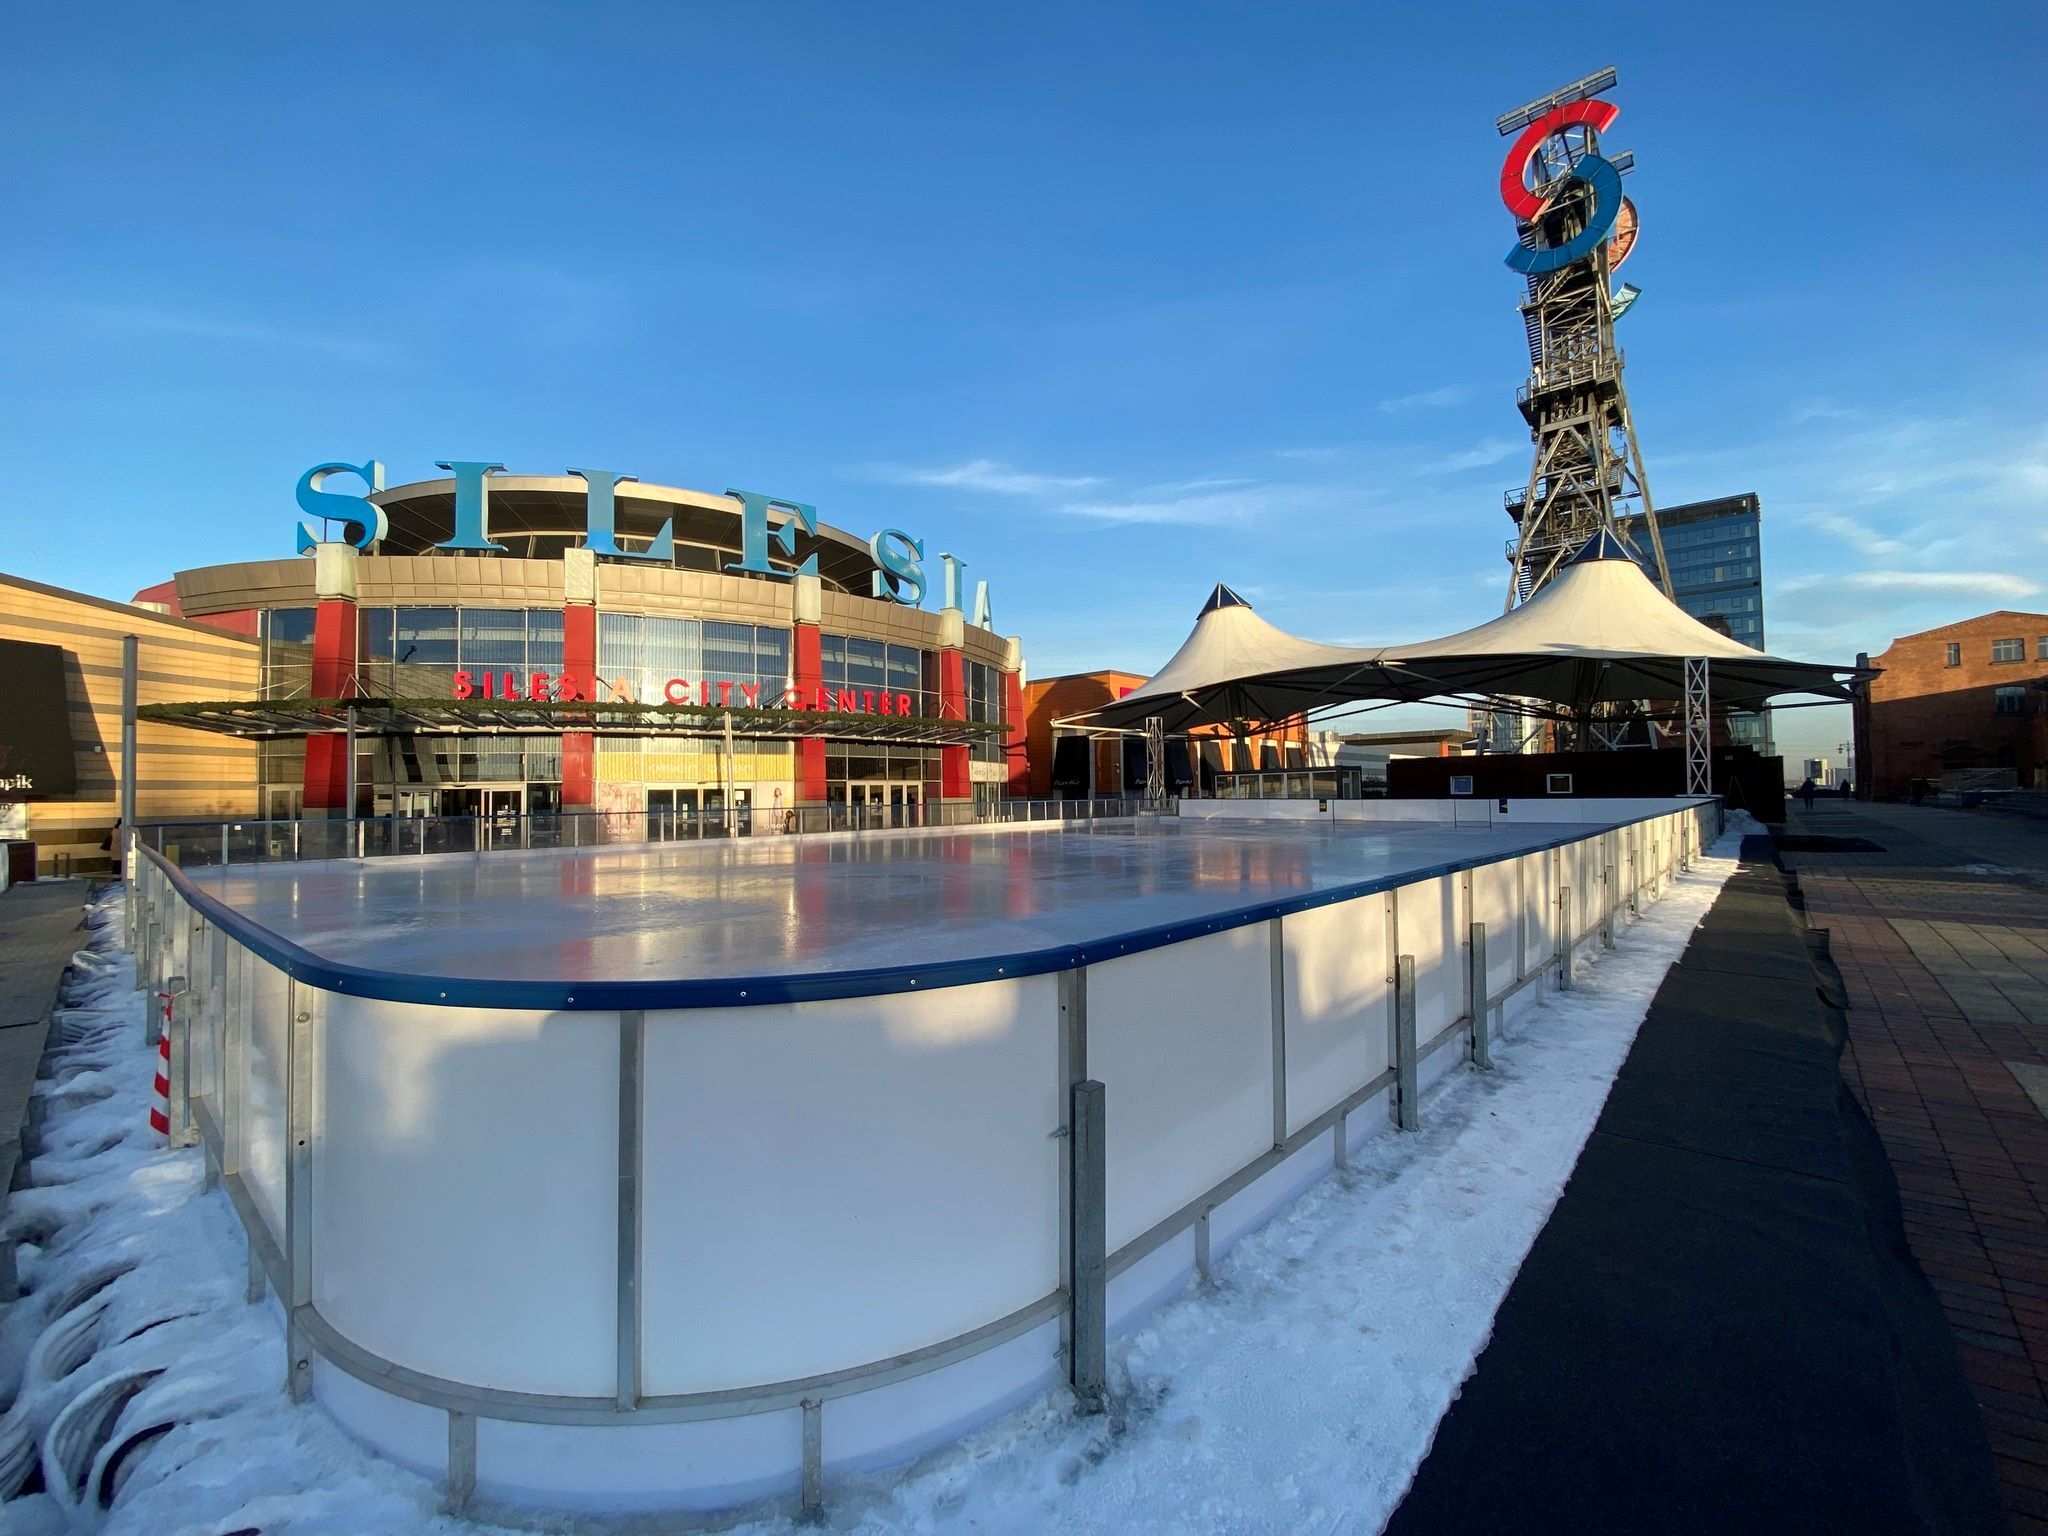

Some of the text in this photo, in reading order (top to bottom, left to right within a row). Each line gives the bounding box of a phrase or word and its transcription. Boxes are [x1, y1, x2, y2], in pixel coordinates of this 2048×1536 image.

[296, 460, 993, 632] SILESIA
[664, 678, 761, 708] CITY
[785, 685, 912, 717] CENTER
